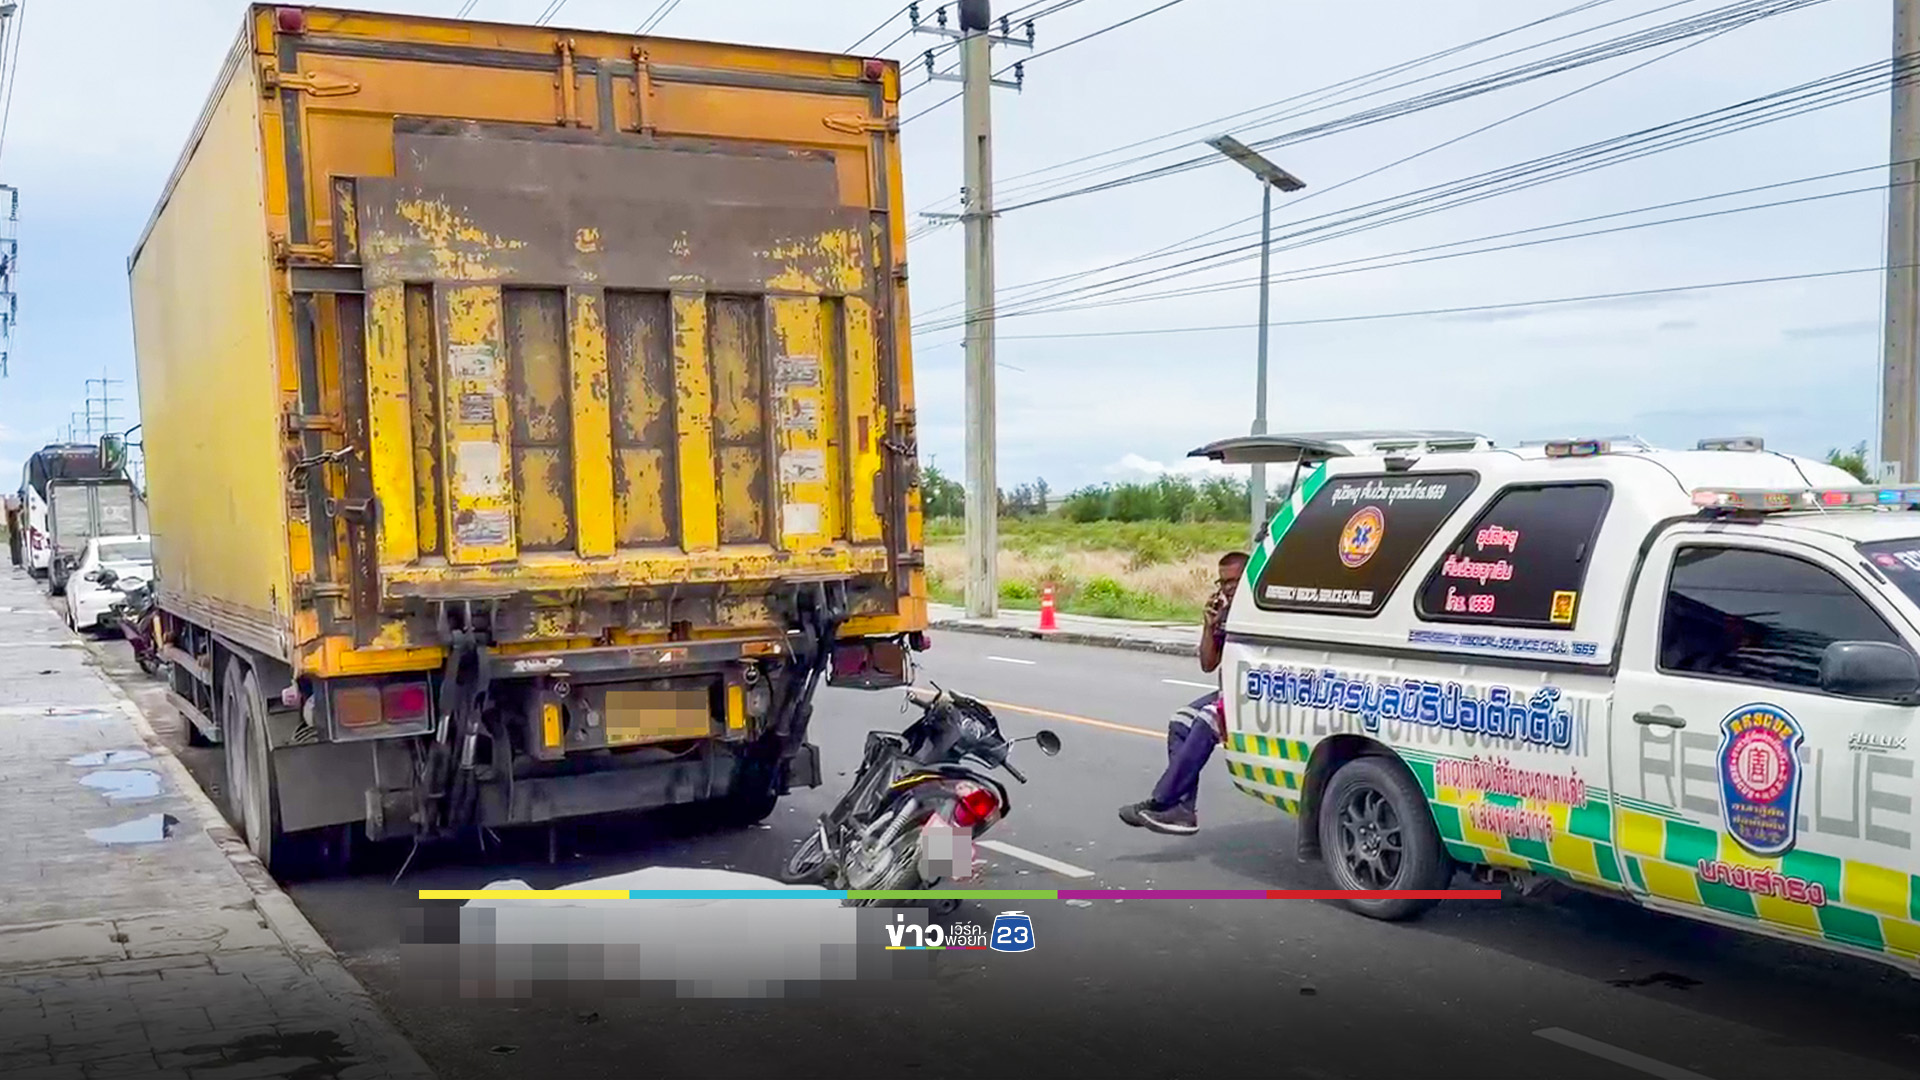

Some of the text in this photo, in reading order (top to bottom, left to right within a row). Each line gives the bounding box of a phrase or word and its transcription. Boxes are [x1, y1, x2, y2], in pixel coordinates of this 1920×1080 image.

[1571, 641, 1599, 656] 1669
[1730, 712, 1794, 739] RESCUE
[1640, 726, 1914, 850] REUE
[1697, 858, 1826, 908] บางเสาธง
